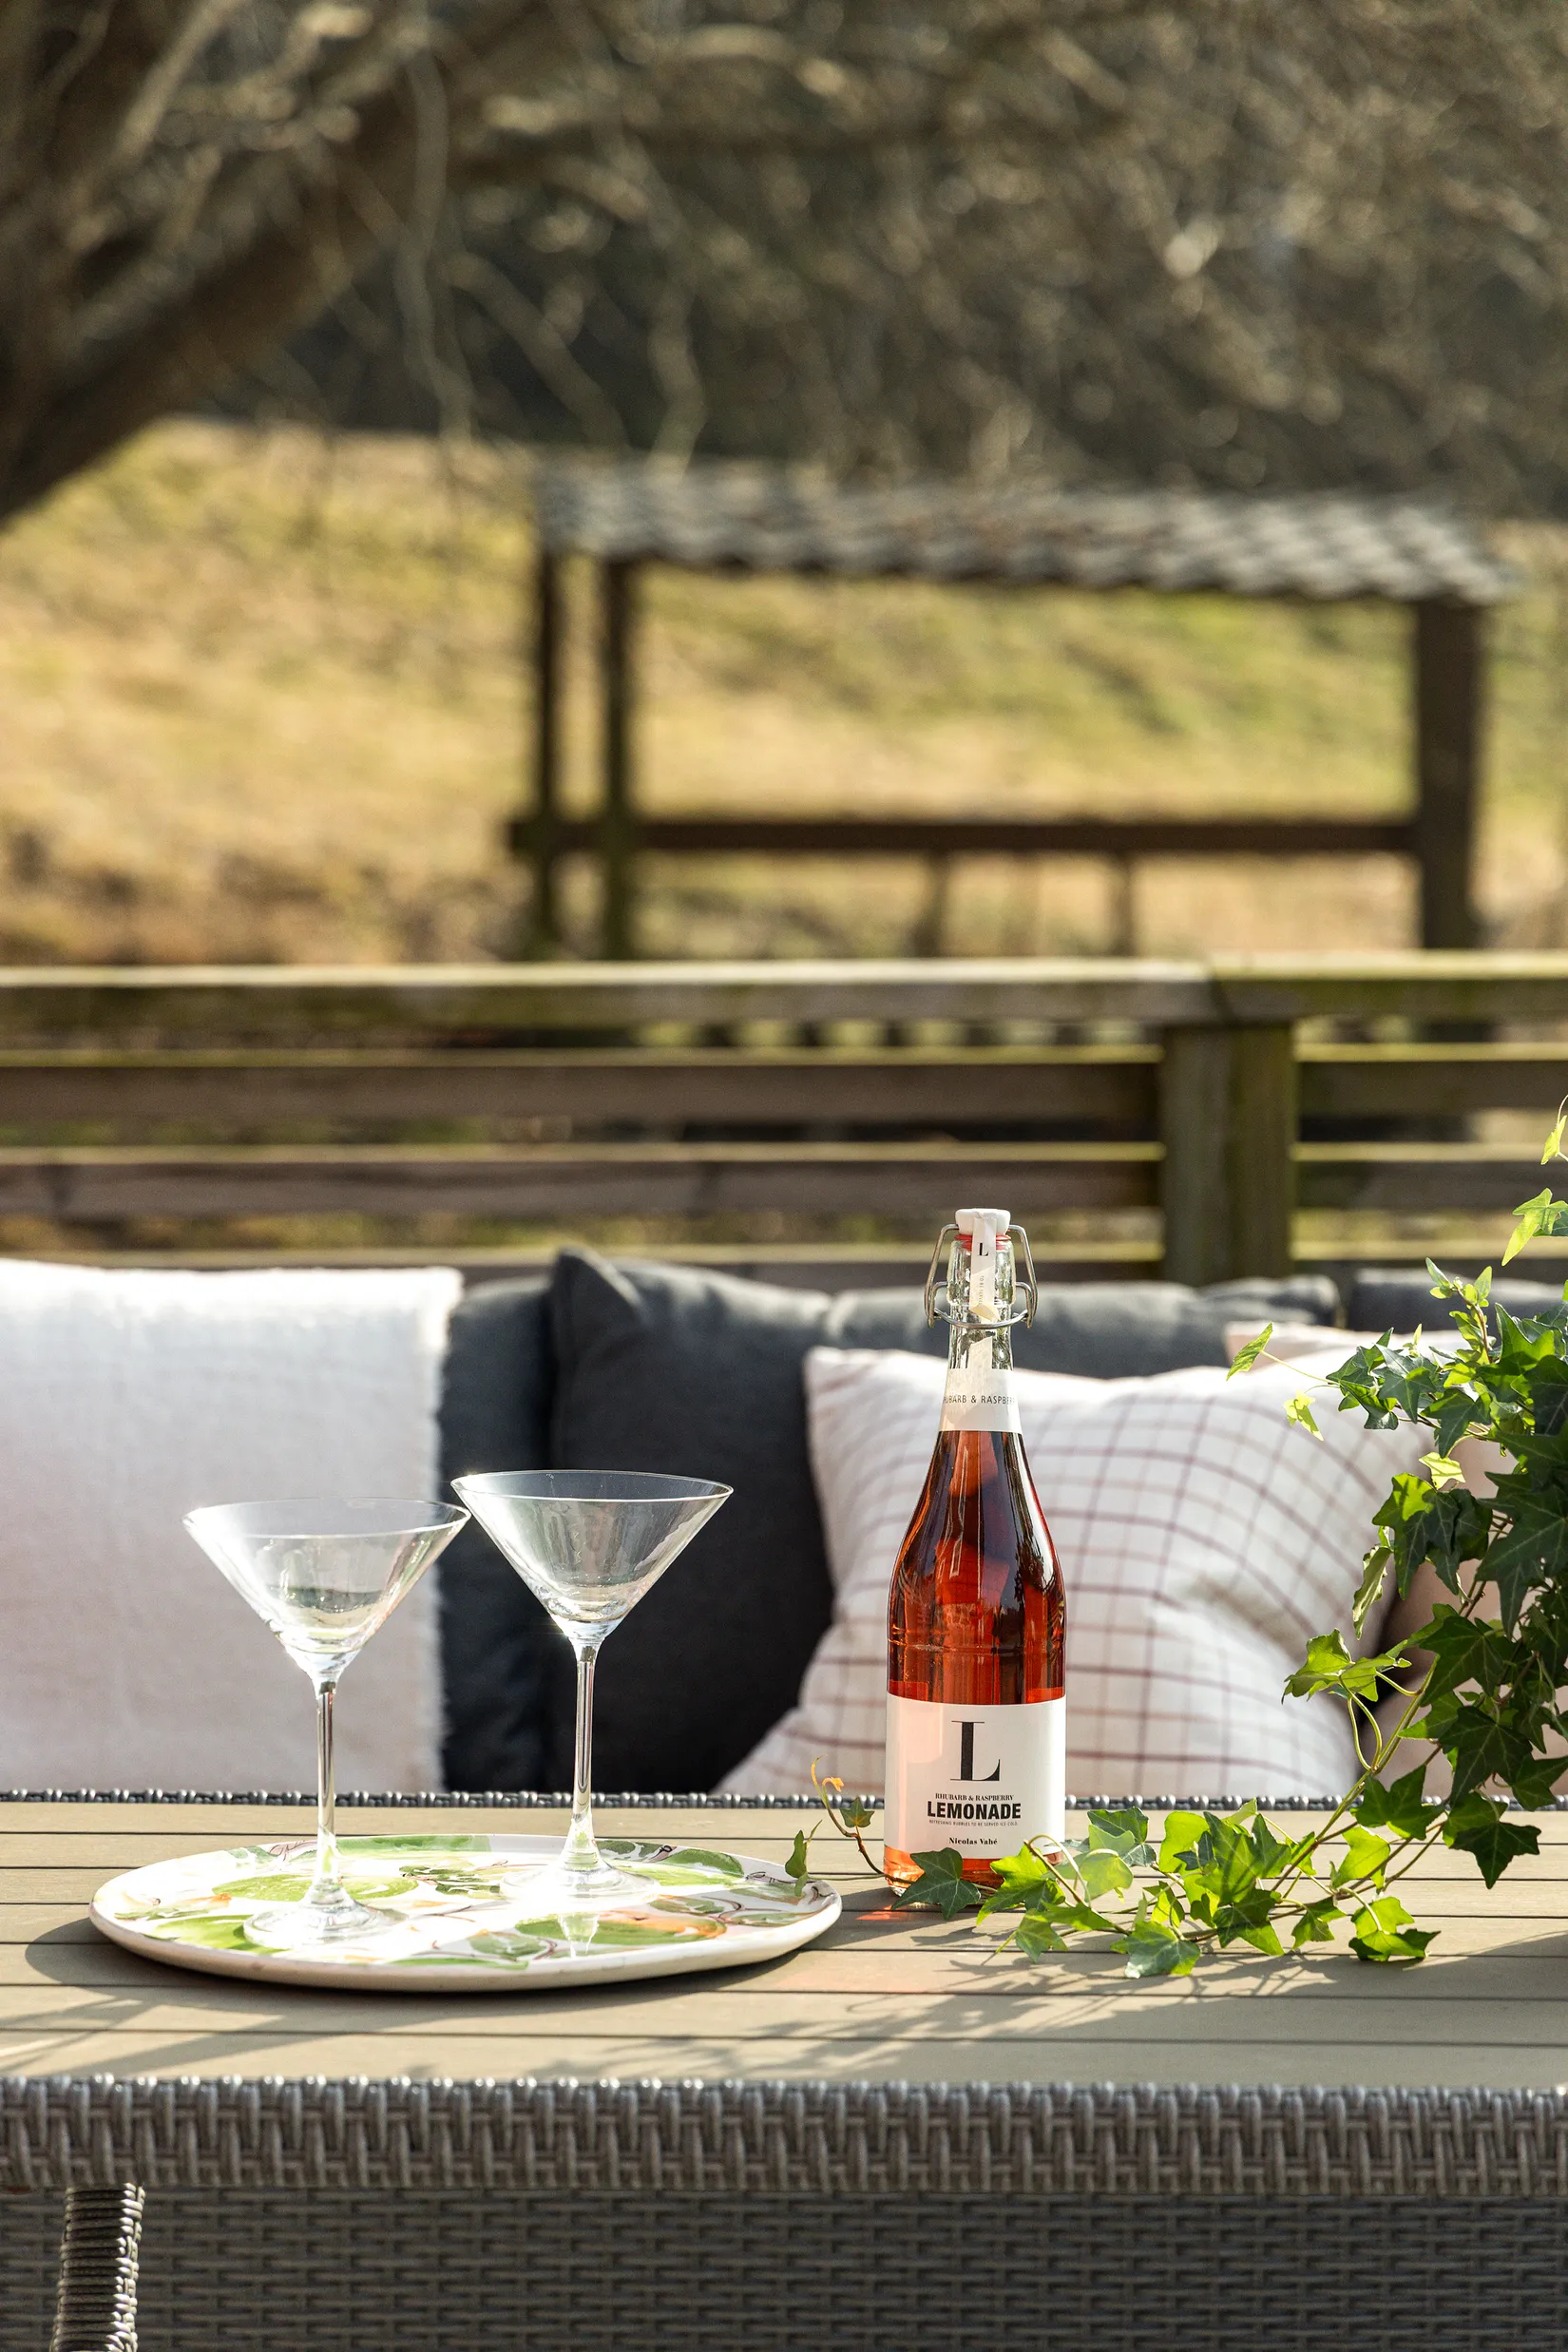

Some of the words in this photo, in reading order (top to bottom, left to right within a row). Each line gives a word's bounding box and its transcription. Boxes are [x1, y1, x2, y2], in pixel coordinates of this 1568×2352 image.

[978, 1242, 989, 1256] L
[971, 1395, 977, 1404] &
[950, 1720, 1001, 1782] L
[935, 1792, 967, 1801] RHUBARB
[927, 1801, 1021, 1820] LEMONADE
[948, 1837, 978, 1845] Nicolas
[980, 1837, 998, 1845] Vahé
